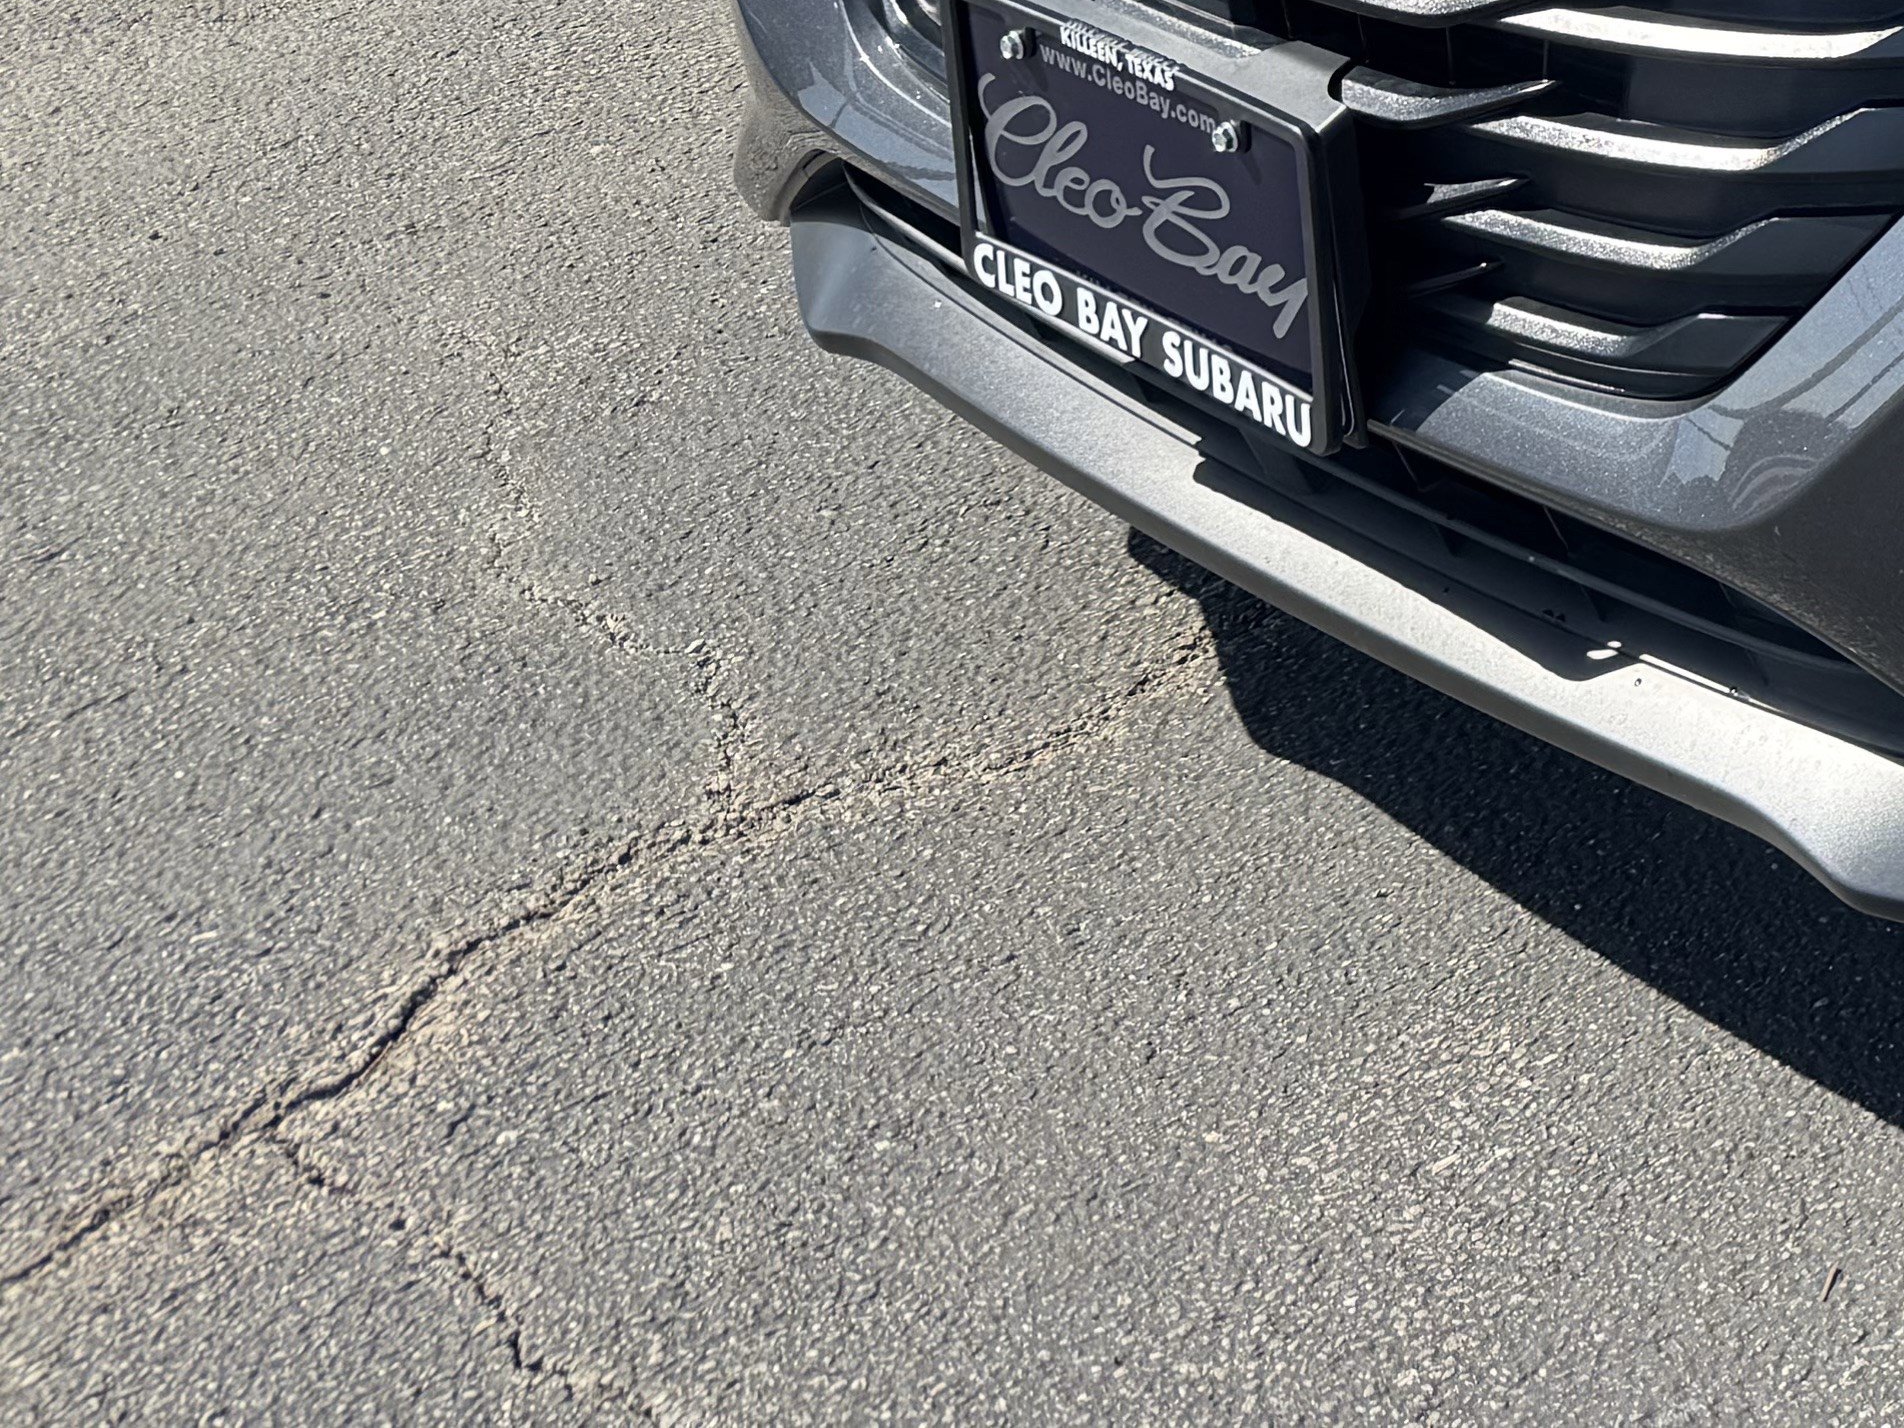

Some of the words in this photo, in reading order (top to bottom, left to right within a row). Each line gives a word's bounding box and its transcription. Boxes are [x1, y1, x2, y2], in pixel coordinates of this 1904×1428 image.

[1039, 43, 1216, 134] www.CleoBay.com
[1059, 25, 1123, 72] KILLEEN,
[1124, 53, 1175, 91] TEXAS
[978, 72, 1142, 229] Cleo
[1141, 144, 1308, 338] Bay
[972, 242, 1063, 318] CLEO
[1076, 287, 1148, 360] BAY
[1161, 331, 1313, 448] SUBARU
